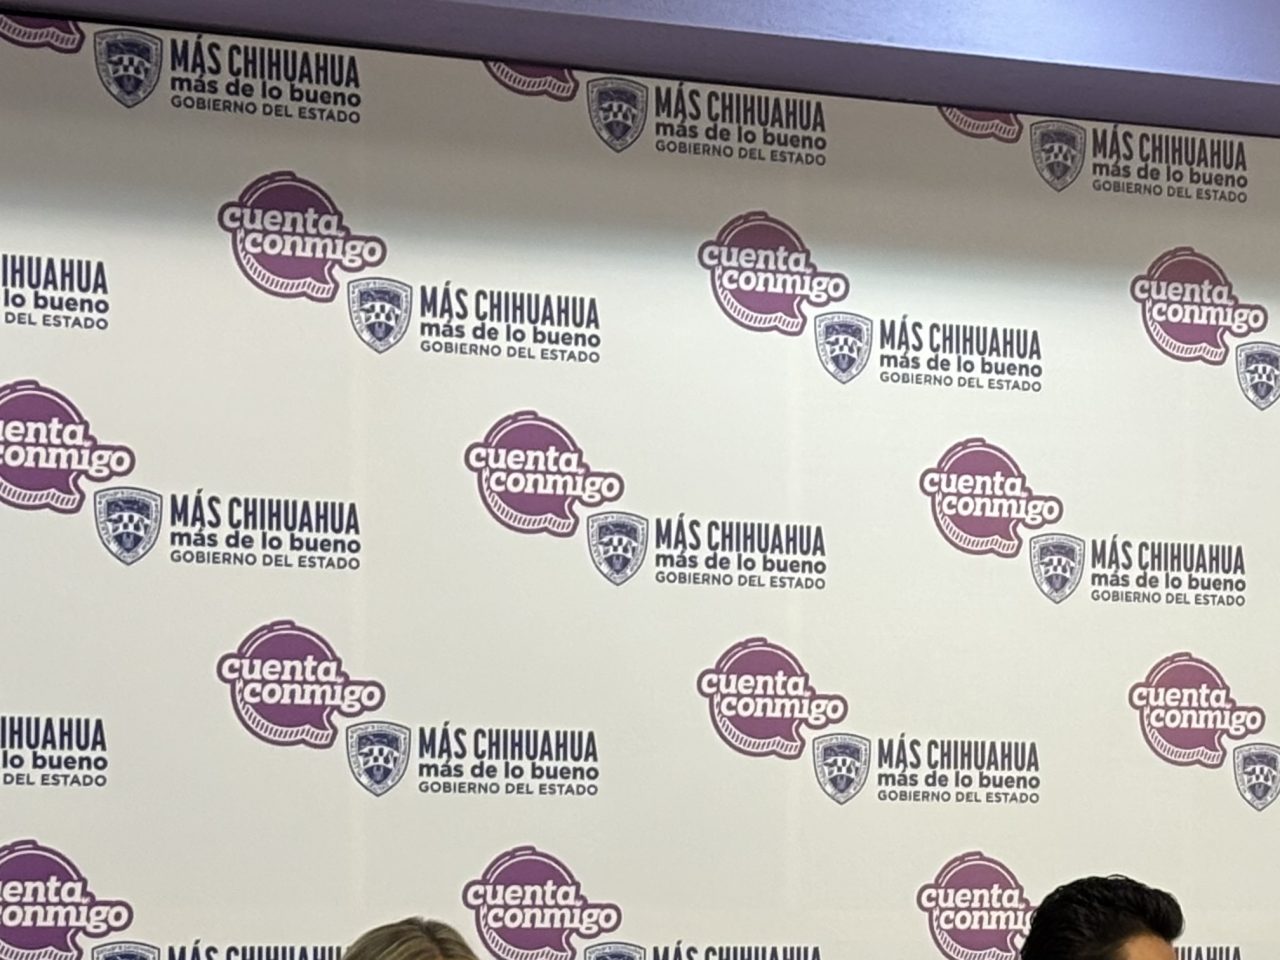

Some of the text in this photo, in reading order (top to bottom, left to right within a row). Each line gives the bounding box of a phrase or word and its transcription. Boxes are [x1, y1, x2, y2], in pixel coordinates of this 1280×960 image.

[171, 32, 360, 89] MÁS CHIHUAHUA
[170, 72, 361, 108] más de lo bueno
[171, 95, 360, 124] GOBIERNO DEL ESTADO
[1093, 123, 1247, 172] MÁS CHIHUAHUA
[1093, 158, 1248, 189] más de lo bueno
[1093, 179, 1247, 203] GOBIERNO DEL ESTADO
[224, 208, 337, 236] cuenta
[245, 233, 382, 267] conmigo
[703, 247, 805, 274] cuenta
[722, 270, 845, 302] conmigo
[1135, 280, 1227, 305] cuenta
[420, 280, 600, 329] MÁS CHIHUAHUA
[1152, 303, 1264, 333] conmigo
[420, 317, 601, 348] más de lo bueno
[420, 340, 600, 363] GOBIERNO DEL ESTADO
[470, 446, 577, 474] cuenta
[490, 472, 620, 502] conmigo
[171, 488, 360, 535] MÁS CHIHUAHUA
[170, 528, 361, 554] más de lo bueno
[656, 512, 826, 556] MÁS CHIHUAHUA
[171, 550, 360, 570] GOBIERNO DEL ESTADO
[655, 548, 826, 574] más de lo bueno
[655, 571, 825, 590] GOBIERNO DEL ESTADO
[222, 656, 337, 683] cuenta
[244, 683, 380, 712] conmigo
[1133, 684, 1226, 708] cuenta
[1150, 709, 1261, 735] conmigo
[419, 721, 598, 762] MÁS CHIHUAHUA
[878, 732, 1039, 772] MÁS CHIHUAHUA
[419, 758, 599, 780] más de lo bueno
[878, 768, 1040, 789] más de lo bueno
[419, 781, 598, 796] GOBIERNO DEL ESTADO
[878, 790, 1039, 804] GOBIERNO DEL ESTADO
[467, 880, 575, 906] cuenta
[488, 908, 617, 934] conmigo
